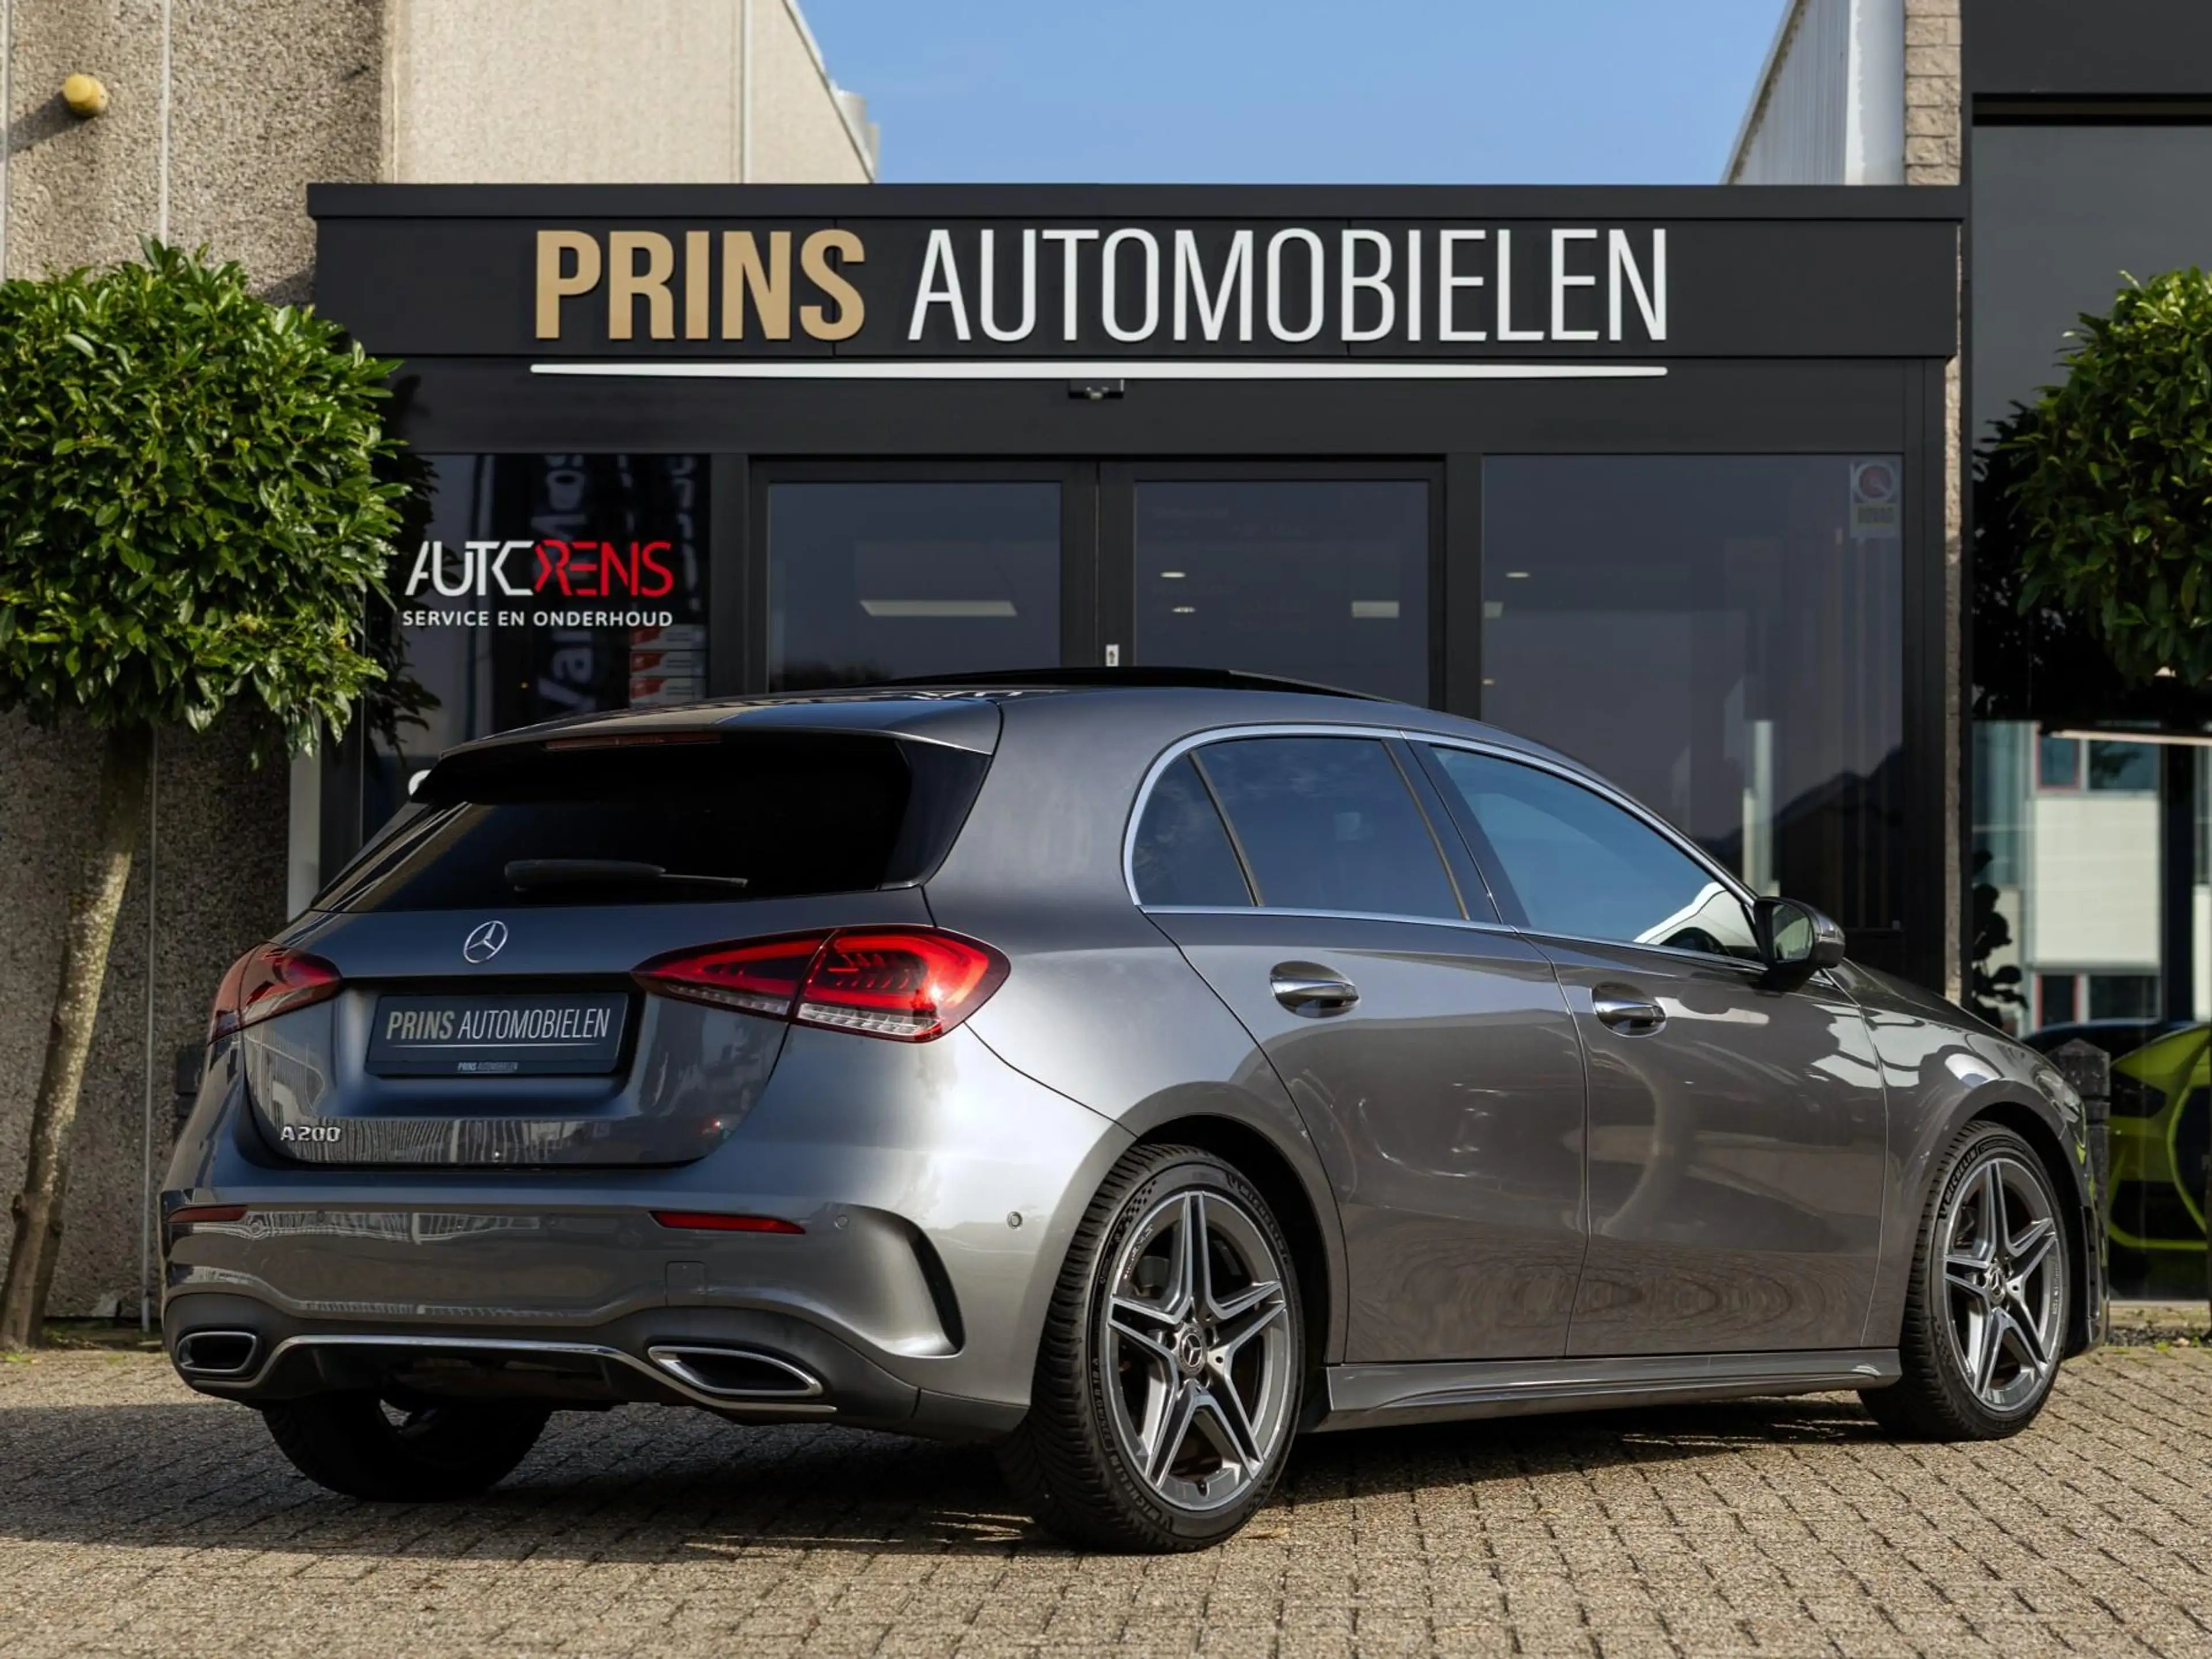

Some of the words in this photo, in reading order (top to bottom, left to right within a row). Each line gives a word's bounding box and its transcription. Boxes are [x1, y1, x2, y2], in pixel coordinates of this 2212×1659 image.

[535, 228, 865, 342] PRINS
[907, 228, 1666, 342] AUTOMOBIELEN
[403, 611, 489, 627] SERVICE
[498, 611, 524, 627] EN
[533, 611, 673, 627] ONDERHOUD
[386, 1010, 455, 1040] PRINS
[458, 1007, 610, 1040] AUTOMOBIELEN
[1108, 1454, 1160, 1523] MICHELIN
